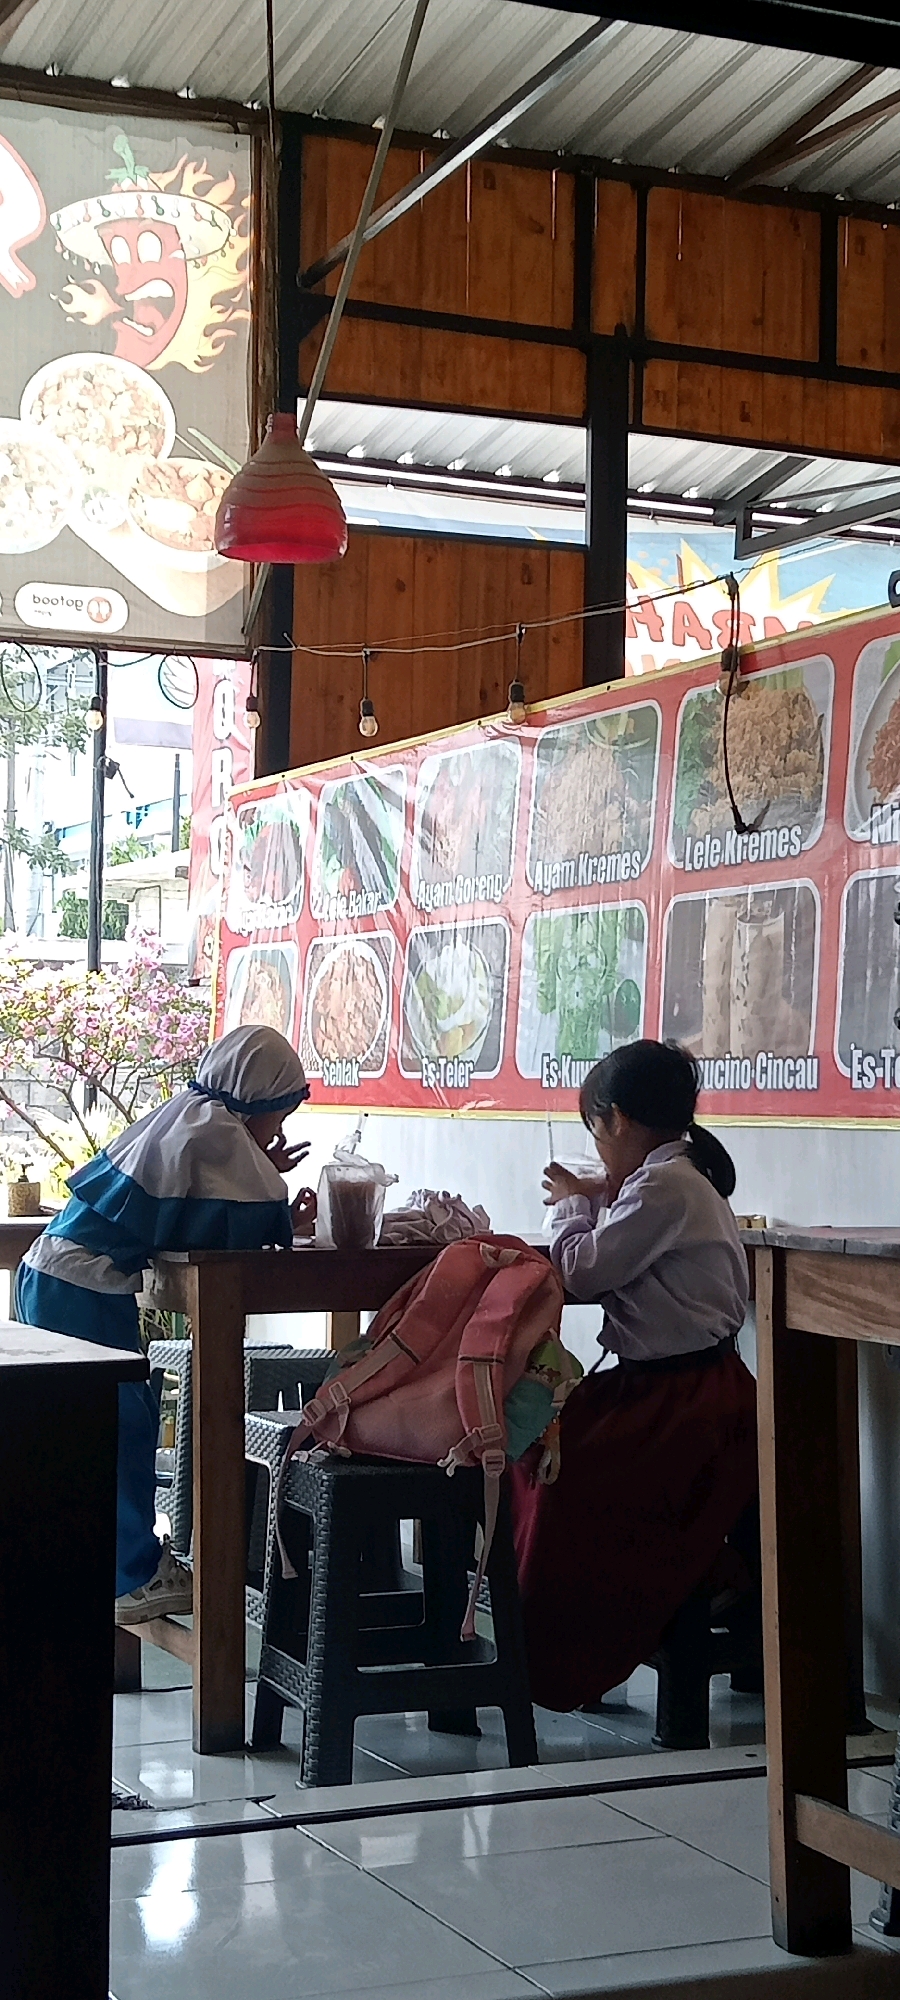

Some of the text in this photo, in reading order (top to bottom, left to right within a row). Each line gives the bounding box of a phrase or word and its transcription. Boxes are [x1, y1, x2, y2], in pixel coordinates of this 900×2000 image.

[684, 825, 801, 871] Lele Kremes
[534, 851, 640, 895] Ayam Kremes
[349, 889, 381, 917] Bakar
[418, 874, 503, 912] Ayam Goreng
[323, 1058, 360, 1086] Seblak
[422, 1057, 474, 1087] Es Teler
[541, 1054, 600, 1088] Es Kuw
[755, 1052, 818, 1090] Cincau
[852, 1049, 876, 1088] Es
